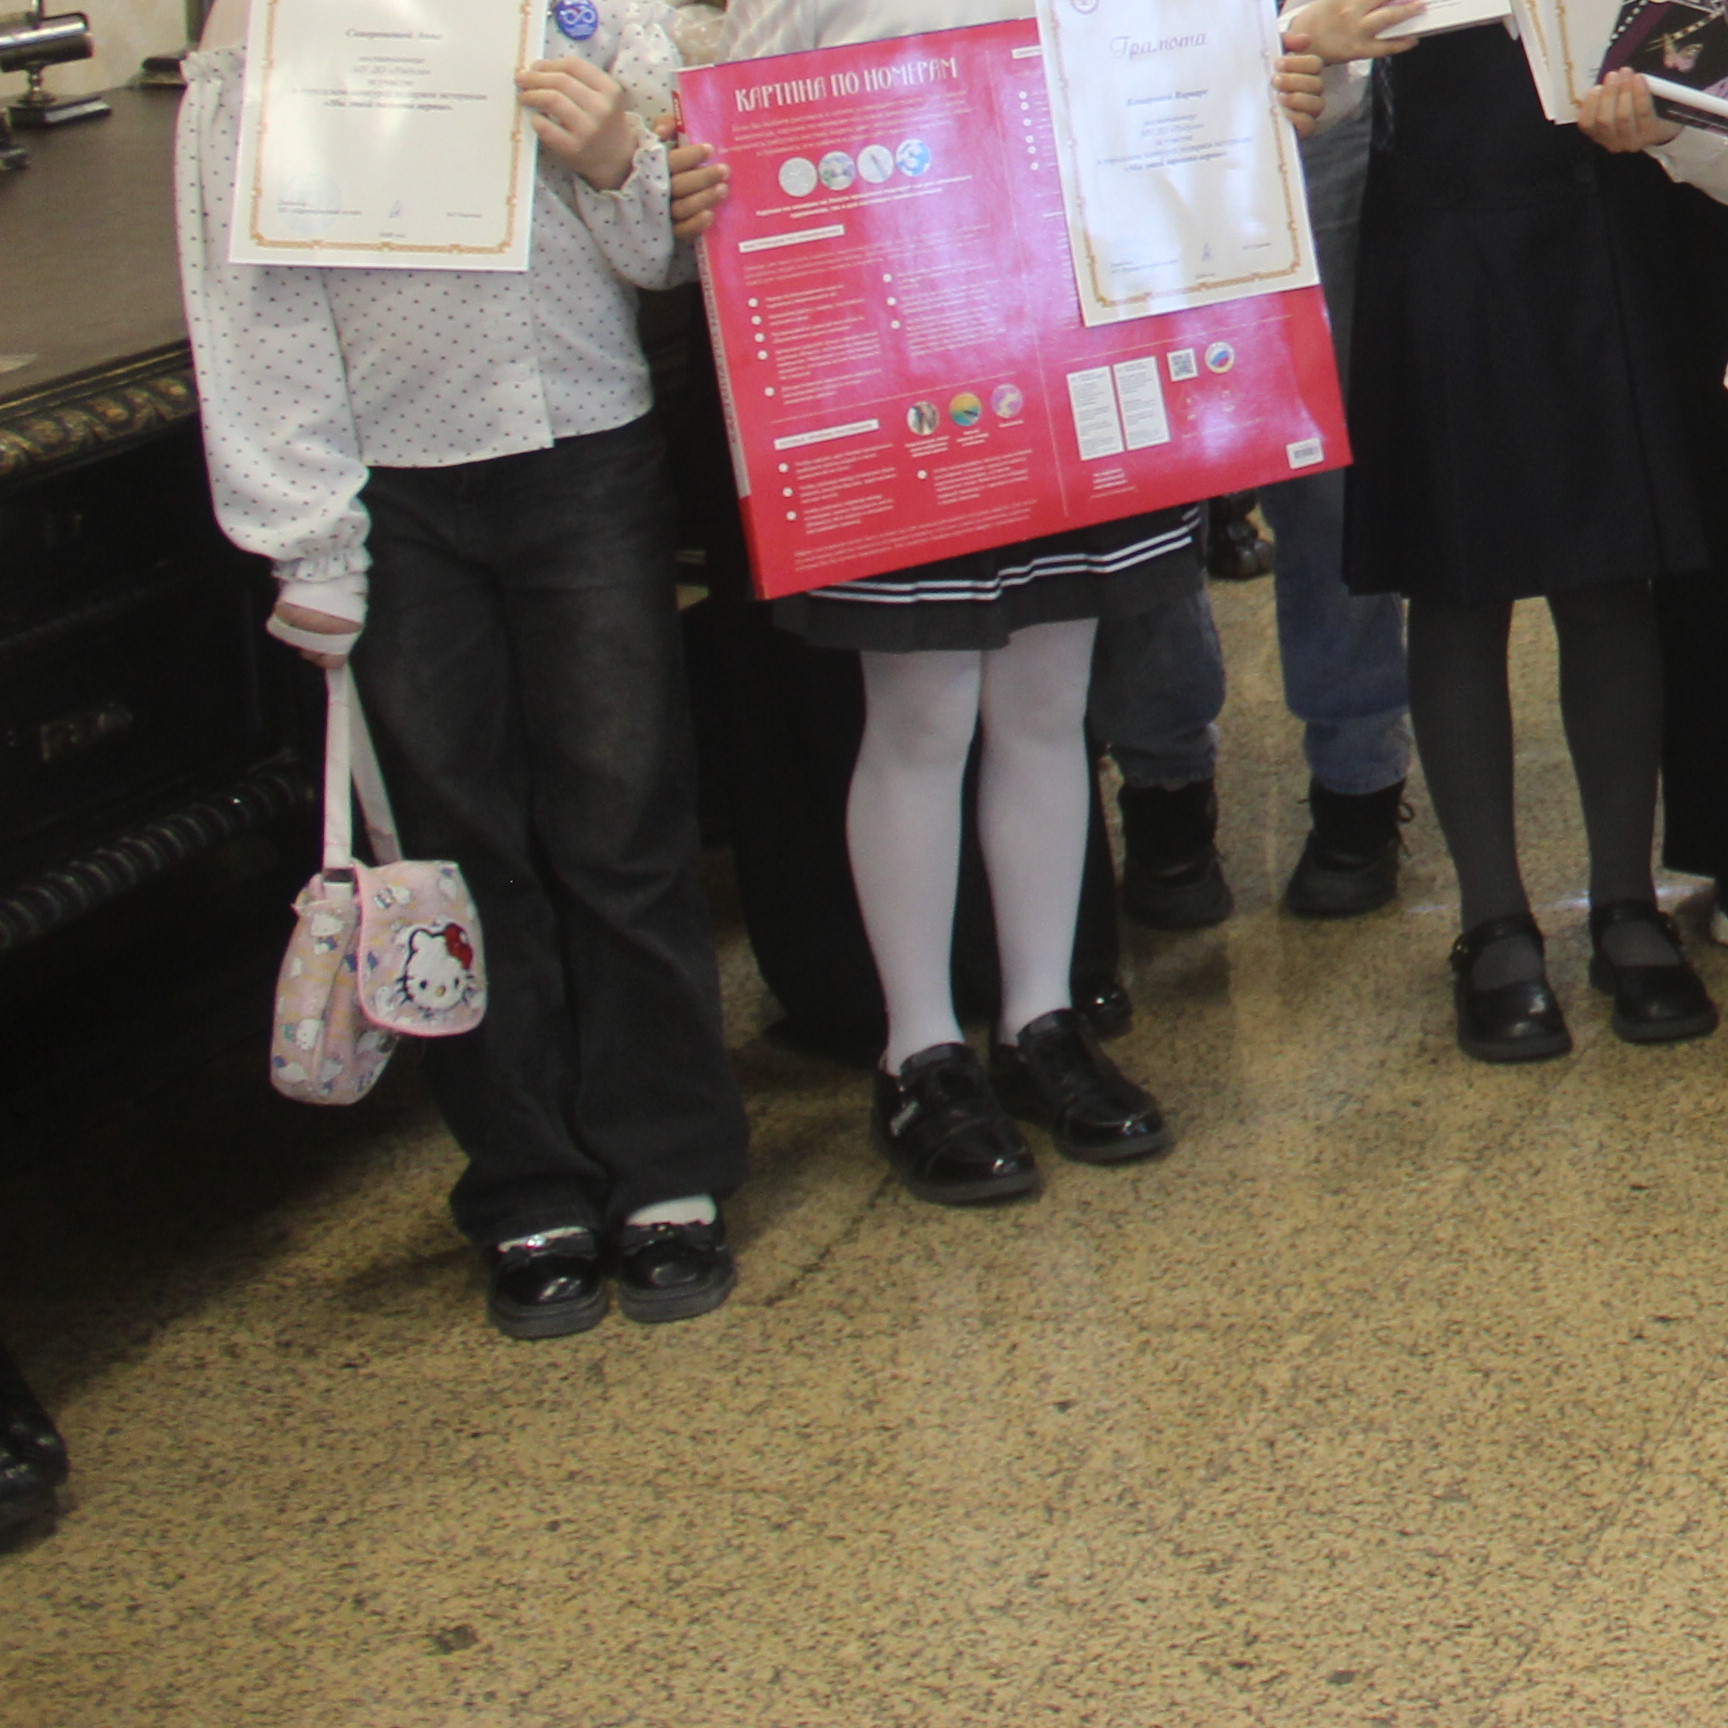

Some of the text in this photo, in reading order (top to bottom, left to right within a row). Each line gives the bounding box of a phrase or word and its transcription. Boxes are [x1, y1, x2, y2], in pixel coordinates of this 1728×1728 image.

[1109, 33, 1207, 60] Грамота
[734, 57, 958, 113] КАРТИНА ПО НОМЕРАМ
